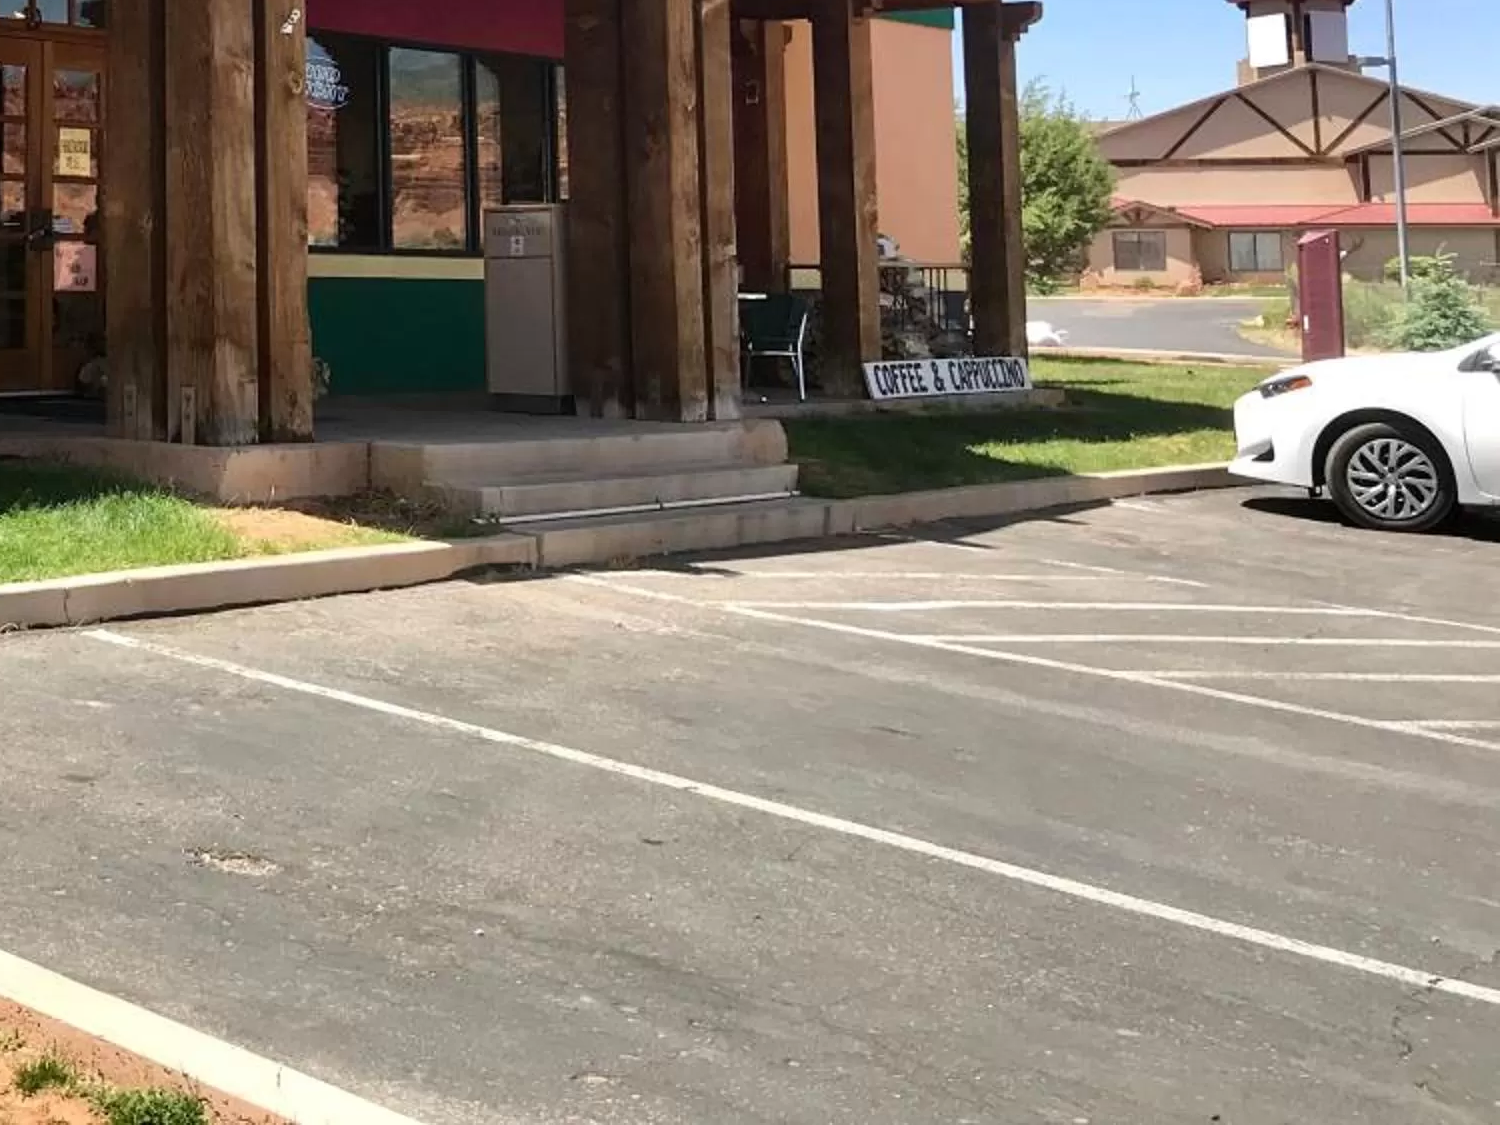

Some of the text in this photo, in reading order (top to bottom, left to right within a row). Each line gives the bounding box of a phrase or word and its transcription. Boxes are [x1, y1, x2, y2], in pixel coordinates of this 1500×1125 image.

[874, 358, 1025, 395] COFFEE & CAPPUCCINO
